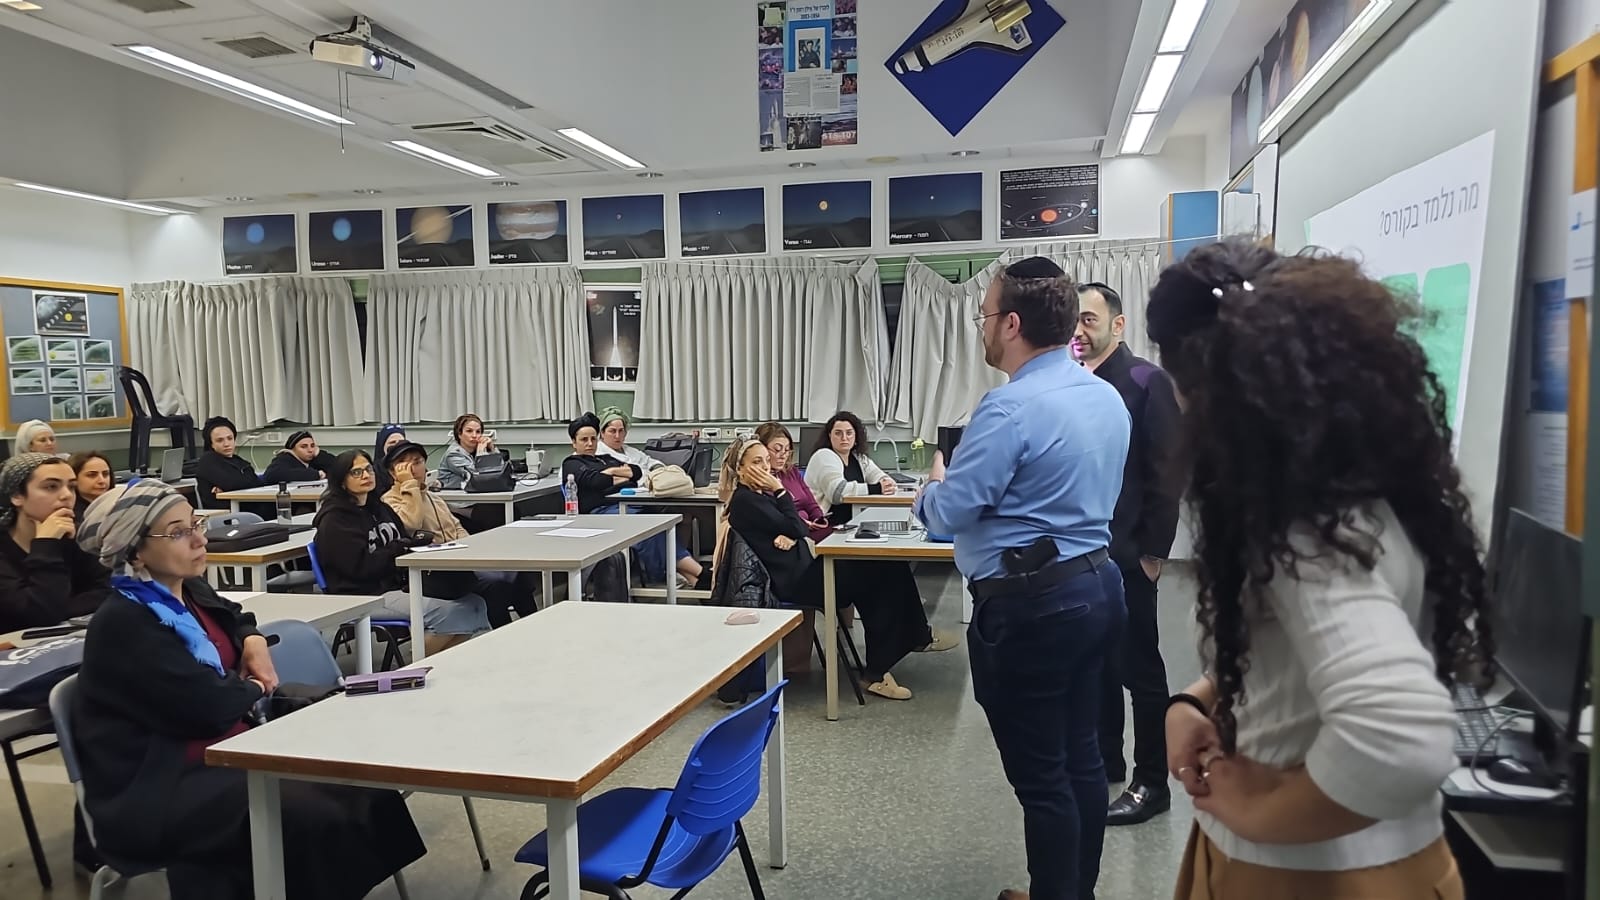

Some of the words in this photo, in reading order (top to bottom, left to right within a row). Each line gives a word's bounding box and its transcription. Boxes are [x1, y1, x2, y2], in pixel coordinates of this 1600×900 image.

[1423, 186, 1454, 225] נלמד
[1458, 182, 1479, 214] מה
[1379, 204, 1419, 239] בקורס?
